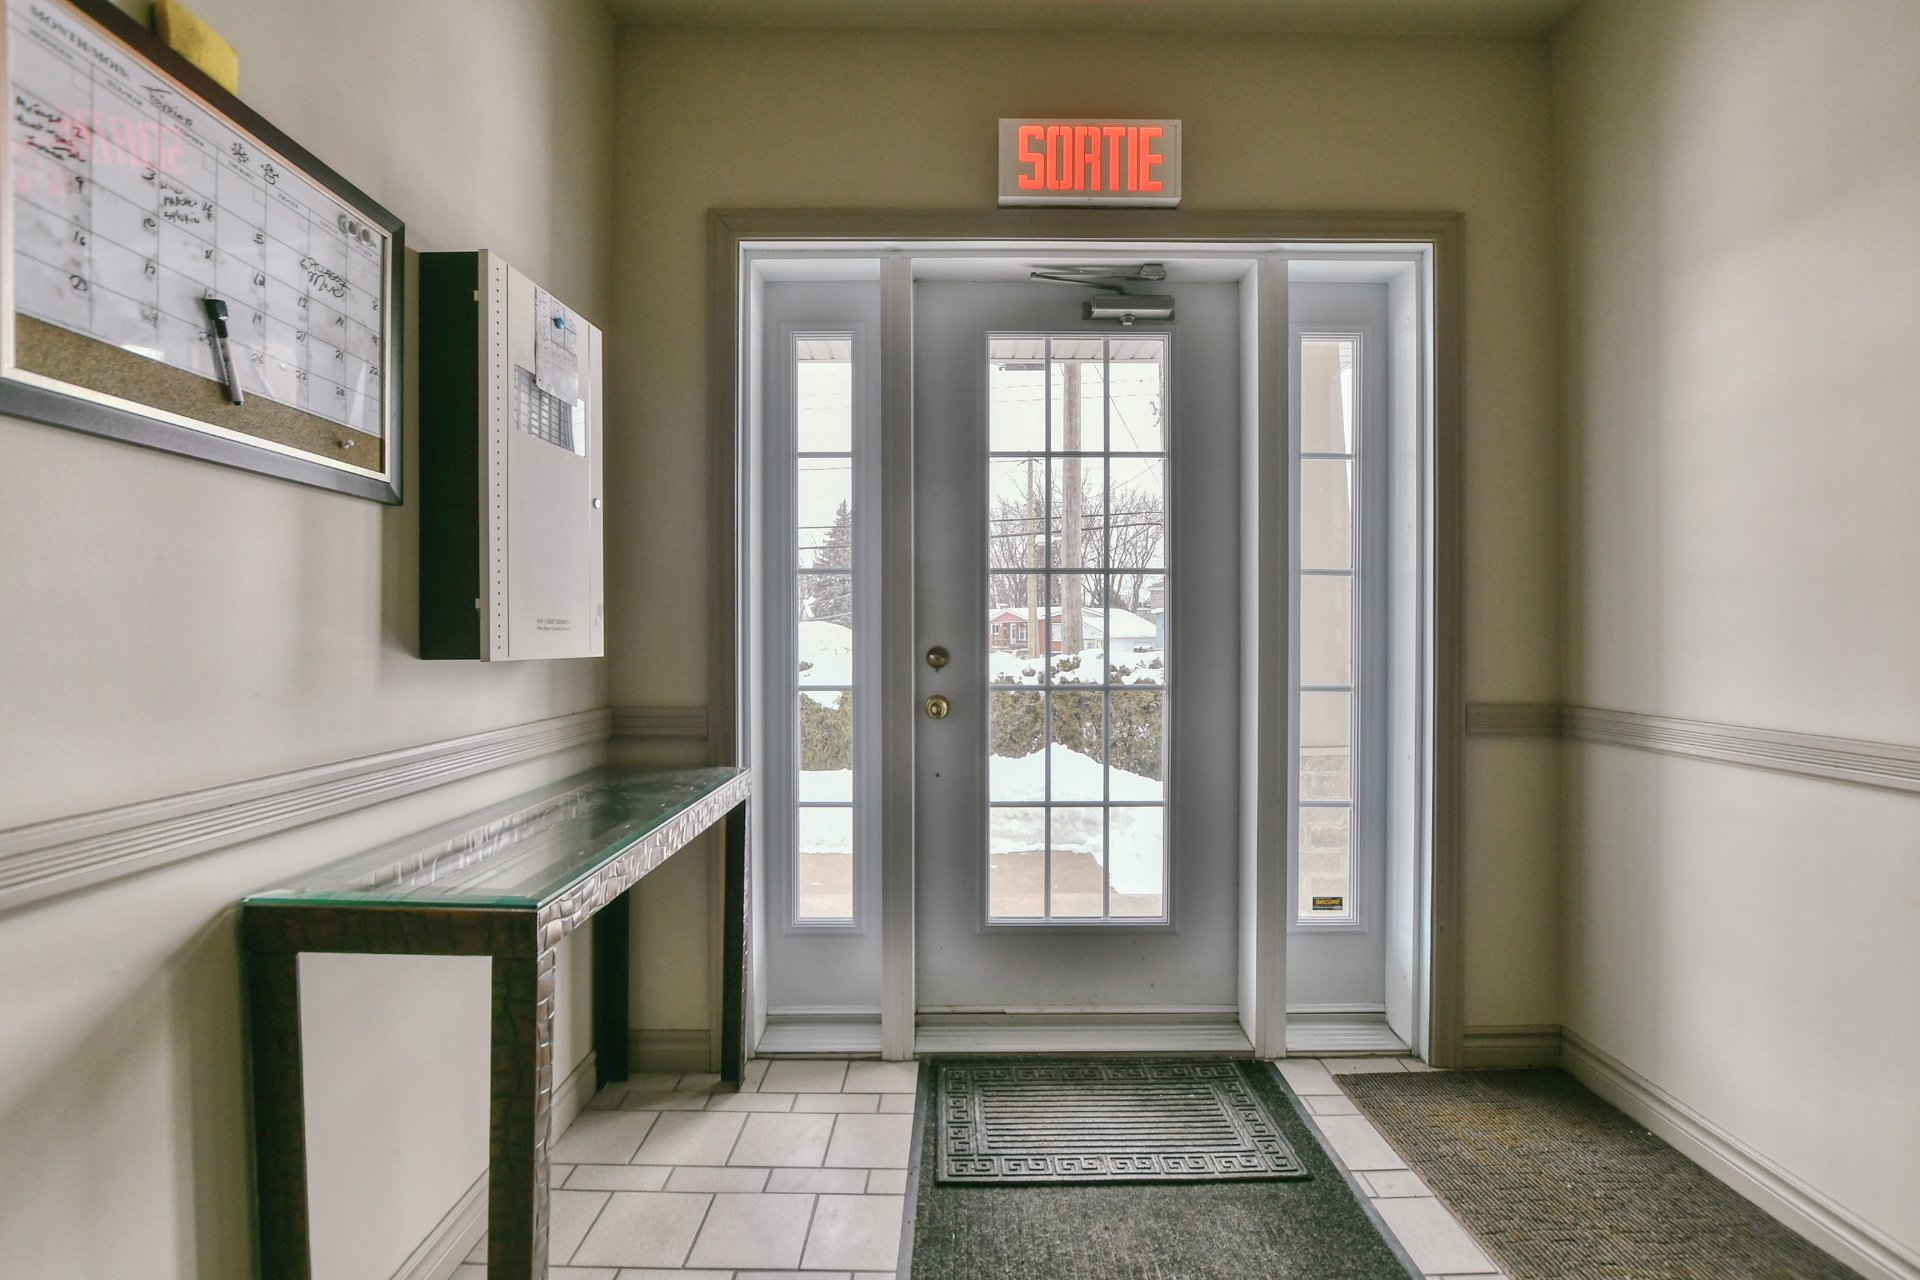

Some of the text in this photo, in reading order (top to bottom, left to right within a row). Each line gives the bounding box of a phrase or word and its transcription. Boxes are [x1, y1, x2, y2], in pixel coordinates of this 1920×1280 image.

[1018, 125, 1163, 191] SORTIE
[142, 166, 157, 181] 3
[75, 176, 84, 193] 9
[74, 231, 87, 246] 16
[252, 312, 262, 325] 19
